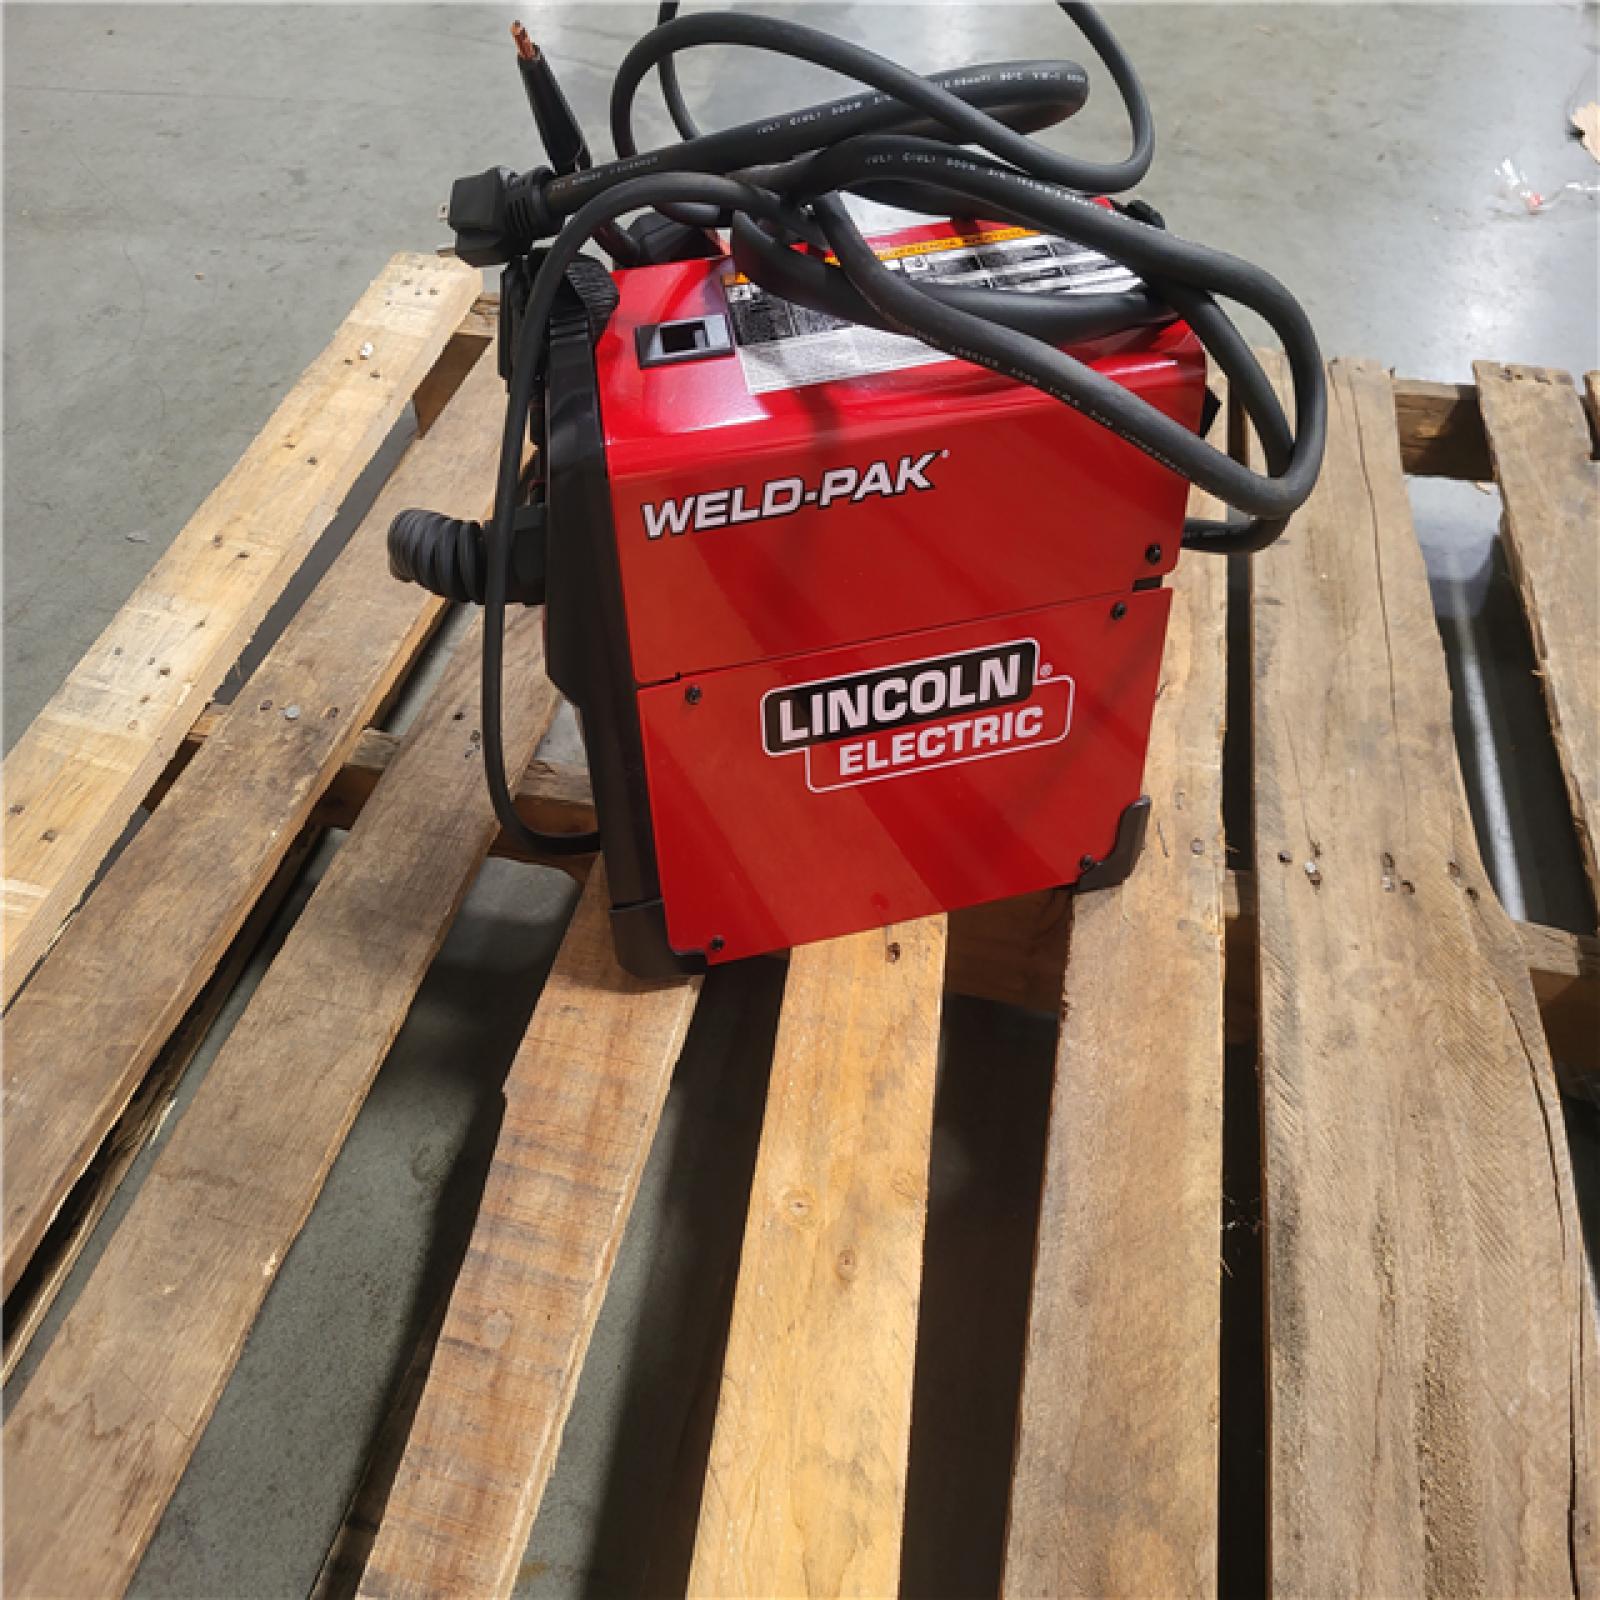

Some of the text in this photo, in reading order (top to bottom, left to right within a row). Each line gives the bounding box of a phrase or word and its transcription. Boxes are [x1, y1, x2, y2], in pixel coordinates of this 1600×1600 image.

[641, 452, 940, 539] WELD-PAK
[779, 654, 1022, 744] LINCOLN
[838, 706, 1044, 777] ELECTRIC
